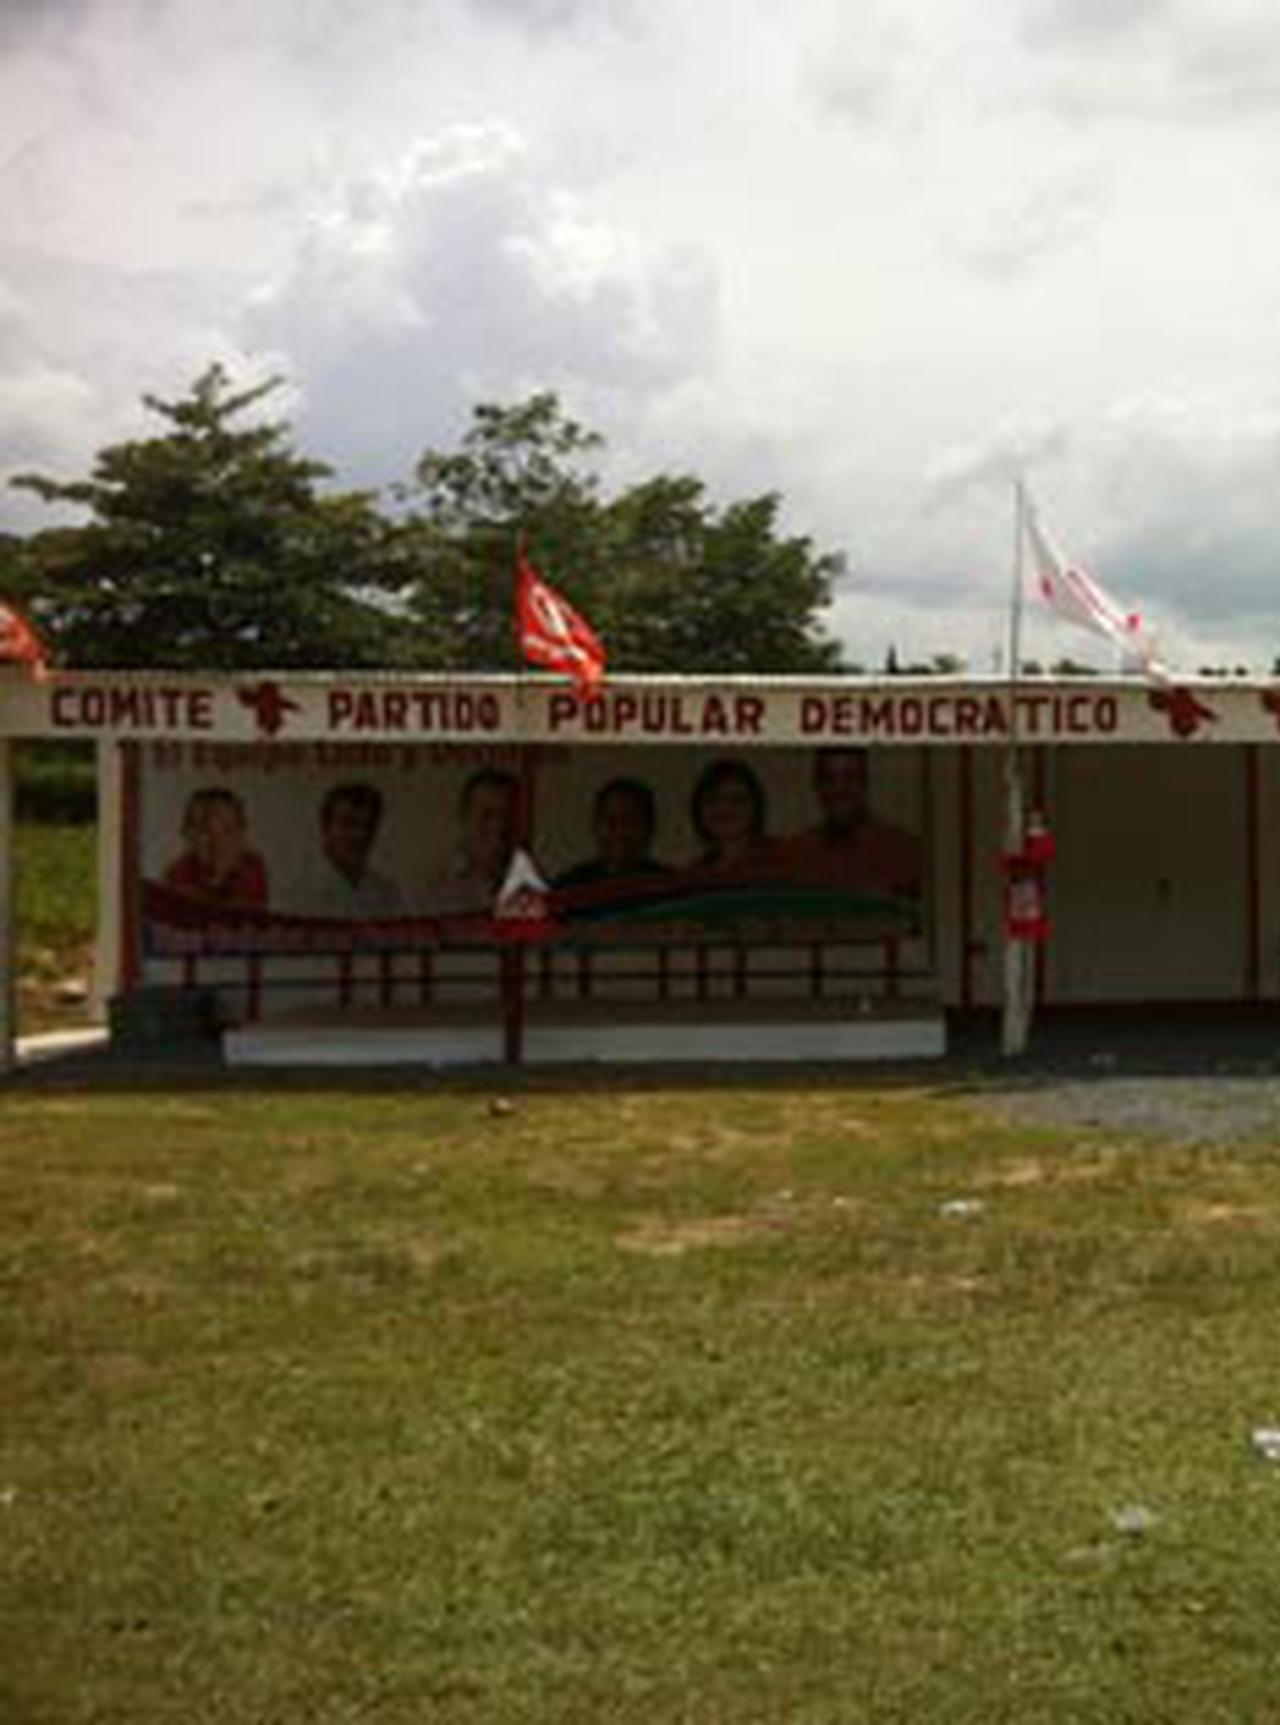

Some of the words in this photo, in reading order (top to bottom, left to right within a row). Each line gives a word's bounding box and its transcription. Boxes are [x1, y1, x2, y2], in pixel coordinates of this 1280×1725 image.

[50, 689, 213, 728] COMITE
[327, 691, 500, 731] PARTIDO
[547, 694, 766, 734] POPULAR
[800, 696, 1118, 735] DEMOCRATICO
